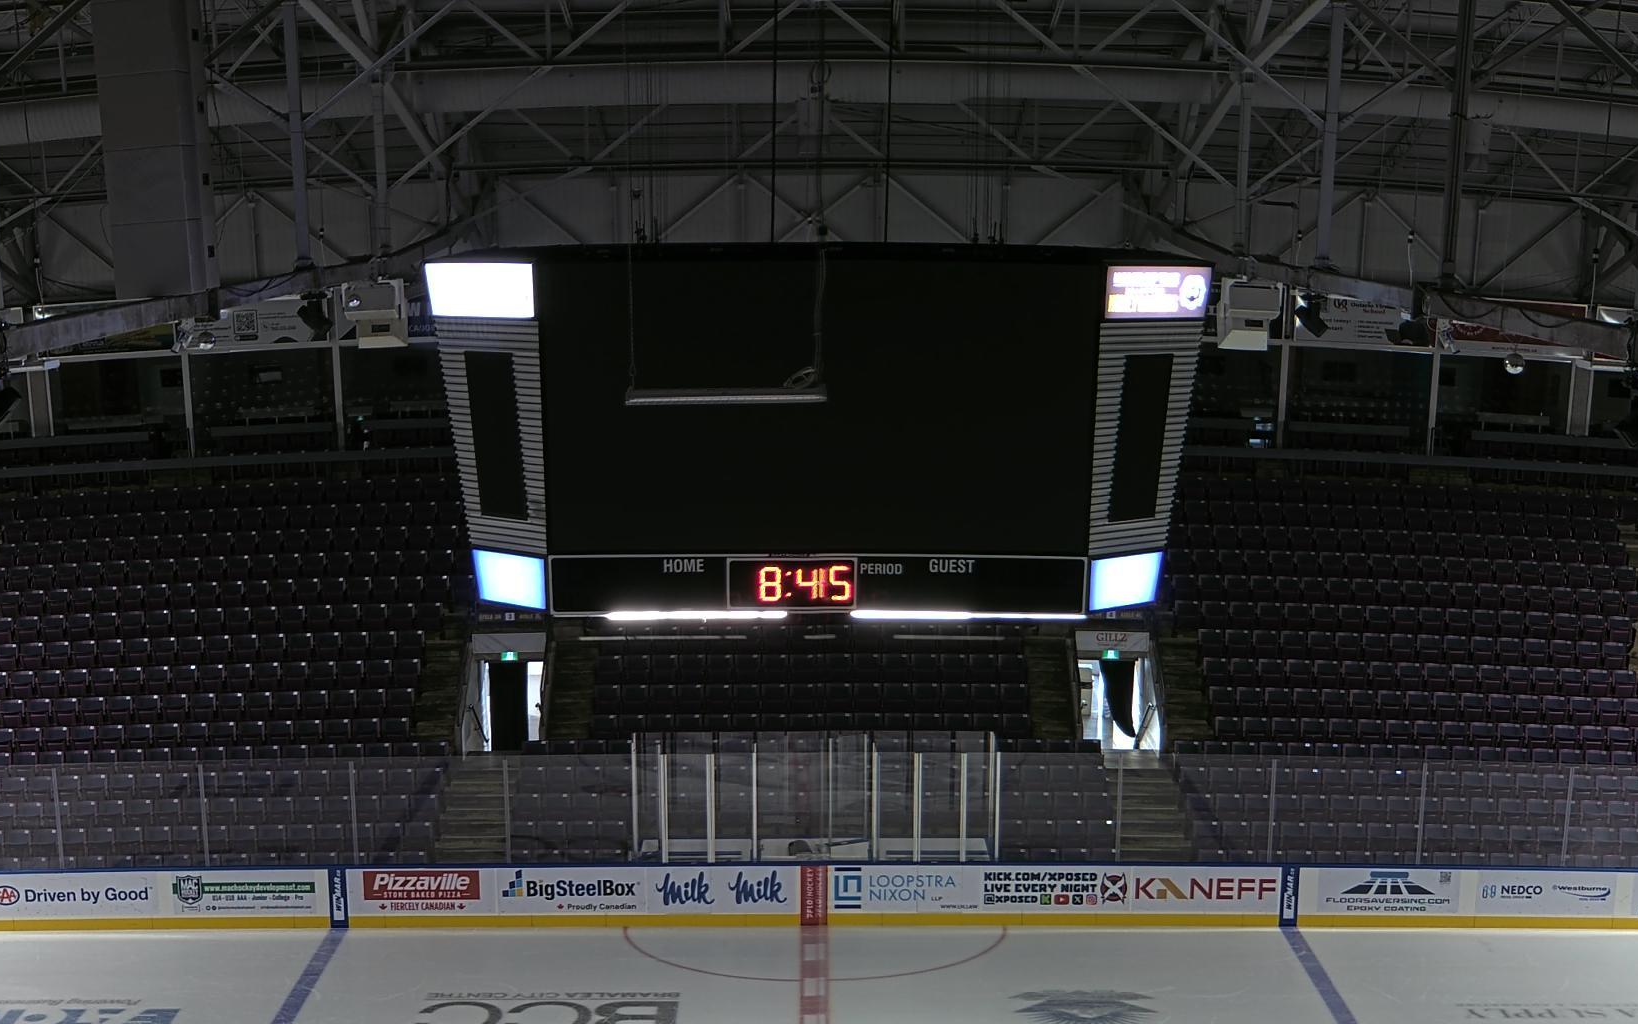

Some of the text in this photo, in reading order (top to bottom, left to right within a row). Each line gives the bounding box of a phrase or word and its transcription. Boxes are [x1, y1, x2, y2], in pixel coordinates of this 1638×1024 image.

[663, 559, 704, 573] HOME
[860, 563, 903, 576] PERIOD
[929, 559, 976, 574] GUEST
[758, 565, 853, 603] 8:45
[373, 873, 470, 891] Pizzaville
[869, 875, 955, 888] LOOPSTRA
[984, 872, 1097, 882] KICK.COM/XPOSED
[180, 879, 198, 889] MAC
[655, 871, 715, 905] Milk
[728, 870, 787, 904] Milk
[984, 884, 1097, 893] LIVE EVERY NIGHT
[1135, 878, 1276, 900] KANEFF
[1501, 885, 1543, 895] NEDCO
[25, 888, 75, 902] Driven
[81, 888, 99, 904] by
[869, 889, 925, 901] NIXON
[984, 894, 1038, 904] @XPOSED
[1325, 897, 1450, 905] FLOORSAVERSINC.COM
[390, 902, 455, 911] FIERCELY CANADIAN
[567, 902, 636, 911] Proudly Canadian
